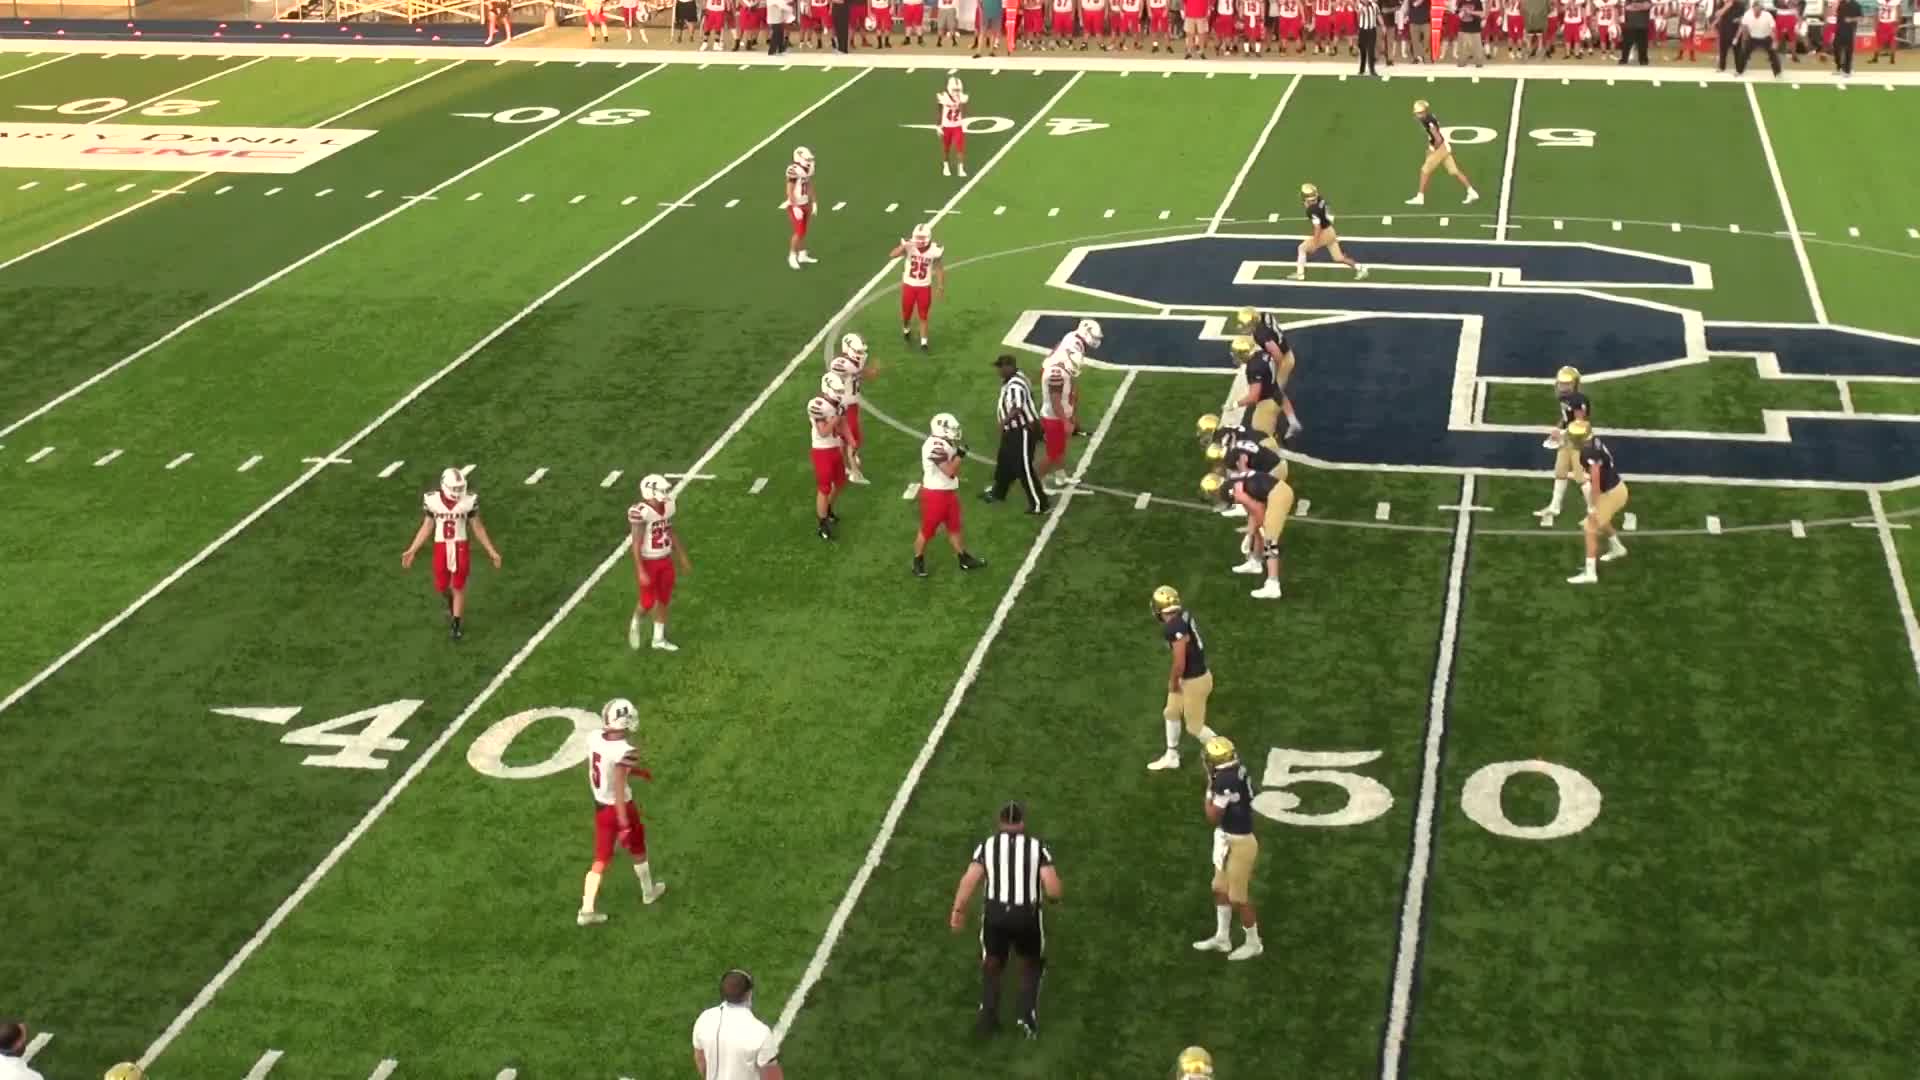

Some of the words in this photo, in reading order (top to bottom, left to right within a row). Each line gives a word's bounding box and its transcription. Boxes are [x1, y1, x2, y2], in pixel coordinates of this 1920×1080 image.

[80, 147, 304, 159] GMC
[909, 261, 929, 280] 25
[443, 520, 456, 540] 6
[591, 751, 602, 789] 5
